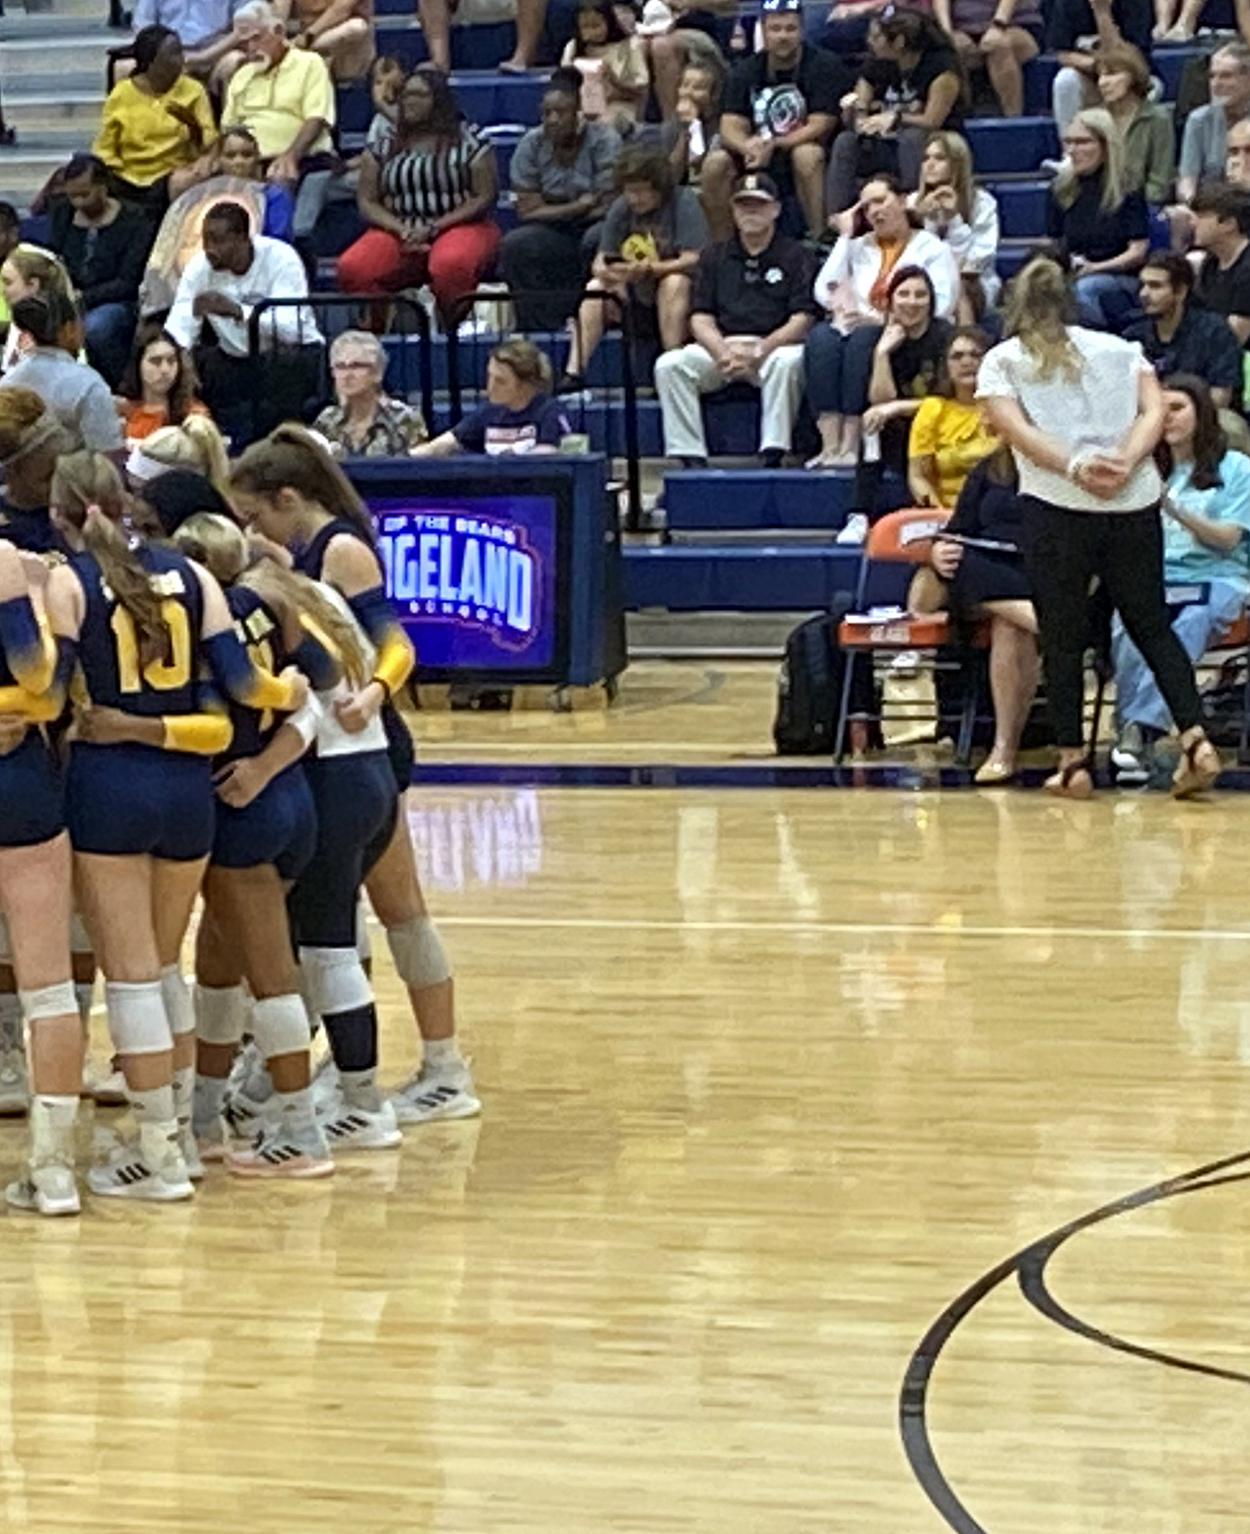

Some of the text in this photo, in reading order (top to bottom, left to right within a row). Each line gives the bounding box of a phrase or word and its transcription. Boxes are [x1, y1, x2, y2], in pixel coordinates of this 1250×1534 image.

[384, 516, 408, 532] OF
[414, 516, 450, 532] THE
[455, 517, 516, 545] BEARS
